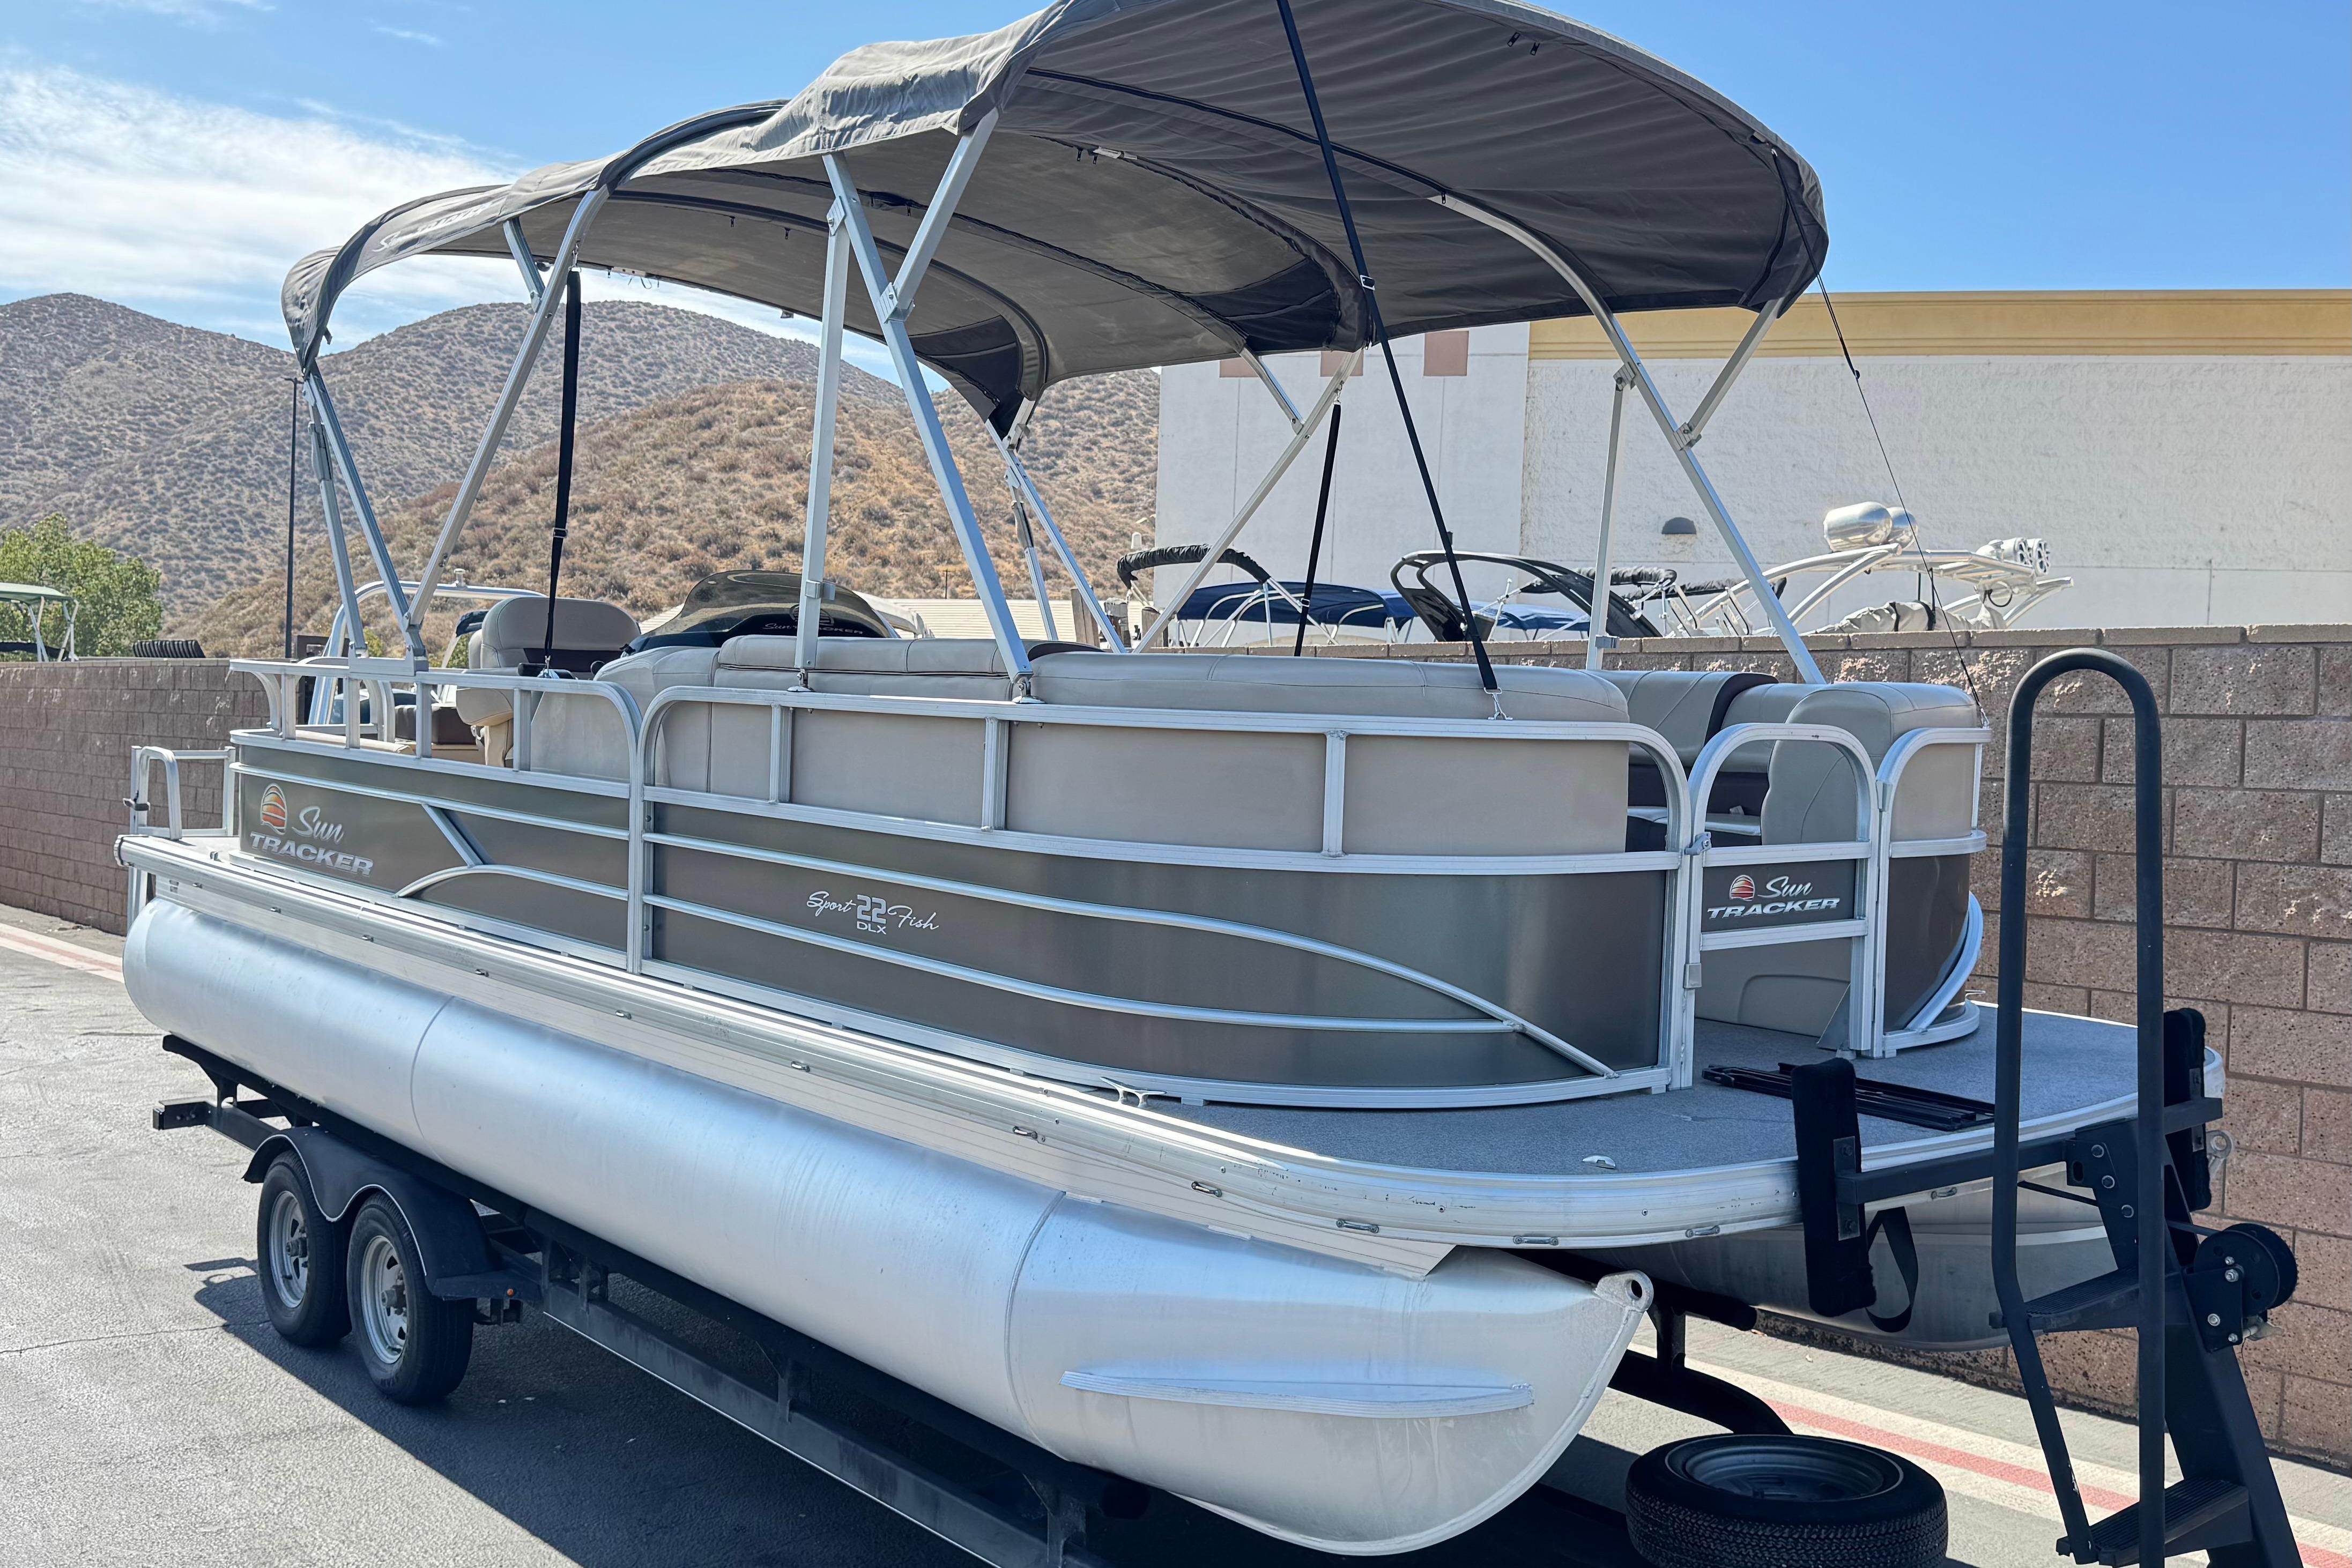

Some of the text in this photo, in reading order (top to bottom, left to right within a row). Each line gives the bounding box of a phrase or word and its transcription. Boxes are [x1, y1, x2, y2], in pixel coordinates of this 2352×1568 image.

[292, 805, 344, 844] Sun
[250, 831, 374, 878] TRACKER
[1757, 875, 1813, 898] Sun
[806, 890, 939, 931] Sport 22 Fish
[1707, 897, 1840, 920] TRACKER
[856, 920, 887, 935] DLX
